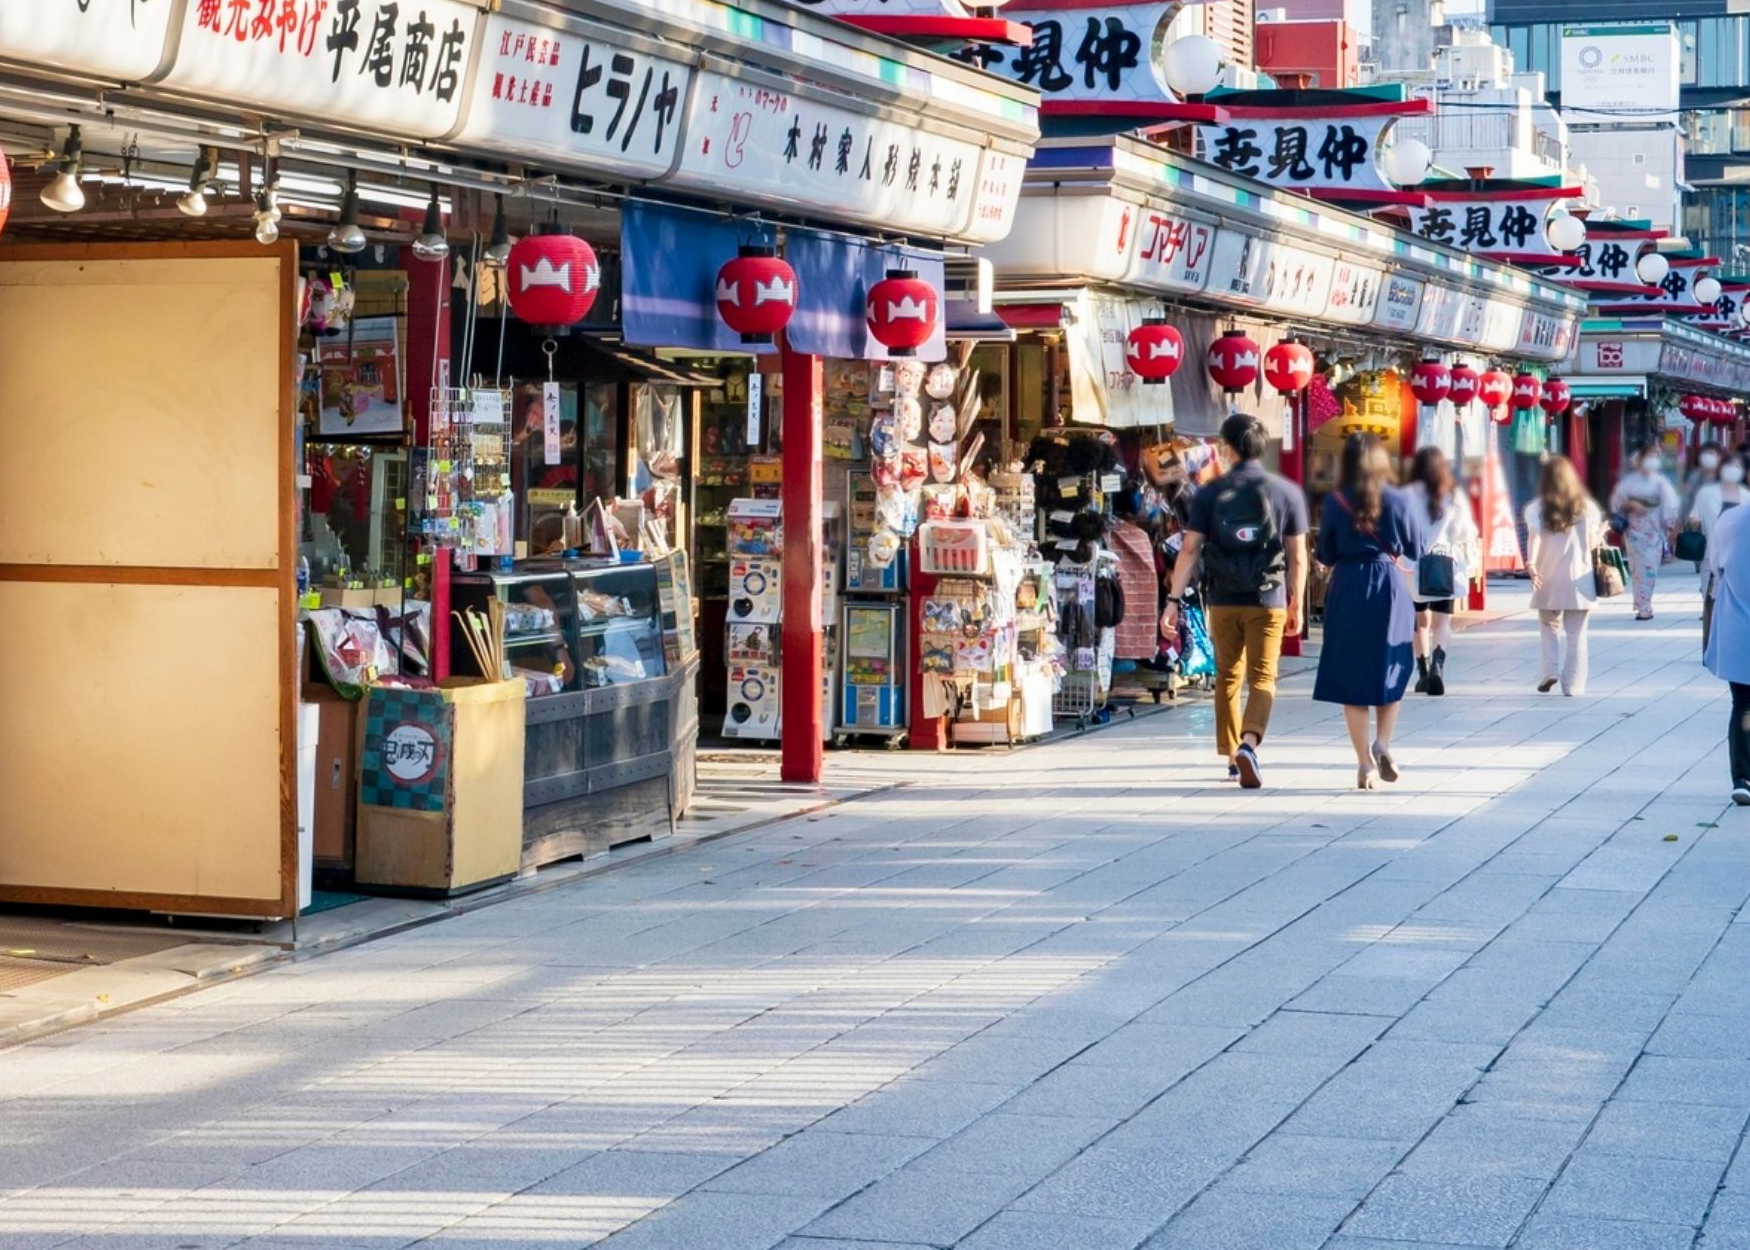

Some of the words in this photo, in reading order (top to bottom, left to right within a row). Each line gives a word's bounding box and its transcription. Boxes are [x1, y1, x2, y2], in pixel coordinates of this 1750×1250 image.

[500, 30, 561, 66] 江戸民芸品
[492, 71, 554, 107] 観光土産品
[570, 44, 678, 154] ヒラノヤ
[1214, 125, 1368, 182] 仲見世
[1419, 205, 1537, 256] 仲見世
